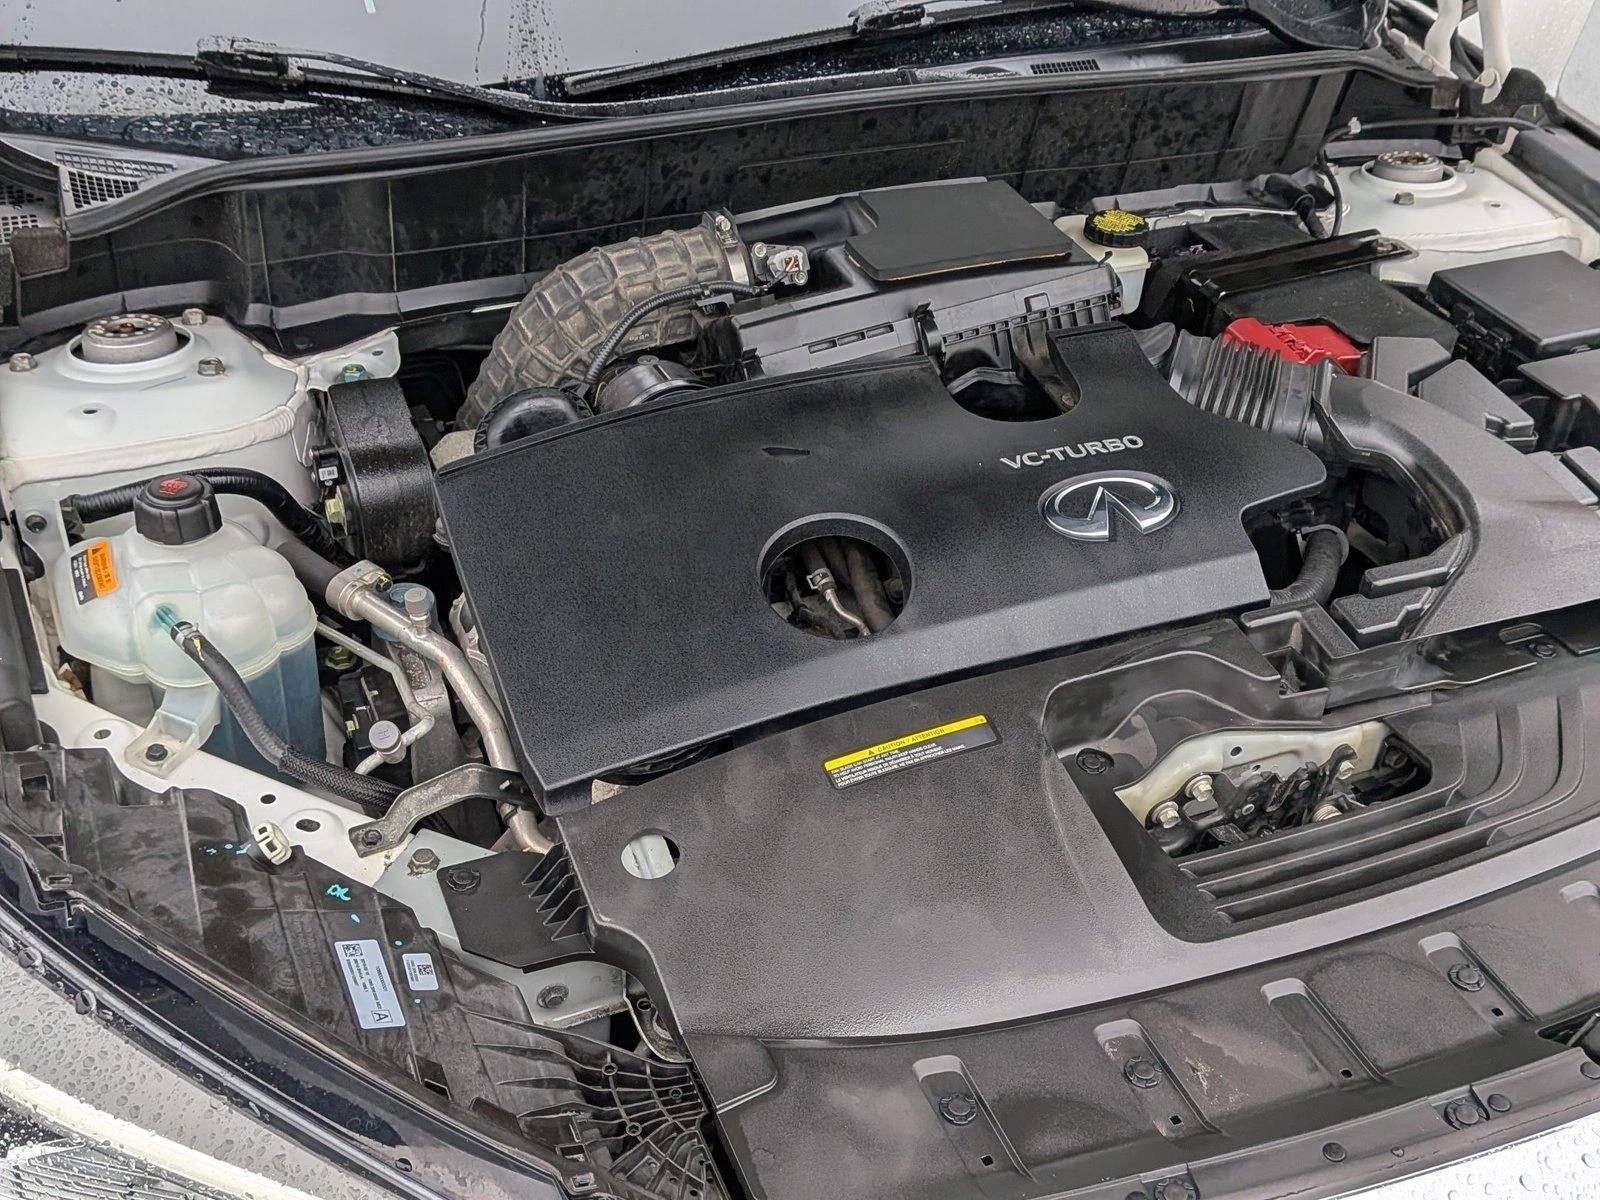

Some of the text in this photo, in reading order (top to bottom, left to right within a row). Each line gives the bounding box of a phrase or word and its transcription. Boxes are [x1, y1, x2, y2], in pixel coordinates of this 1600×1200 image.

[1000, 435, 1144, 470] VC-TURBO
[878, 740, 905, 752] CAUTION
[912, 728, 945, 742] ATTENTION
[374, 1012, 388, 1022] A
